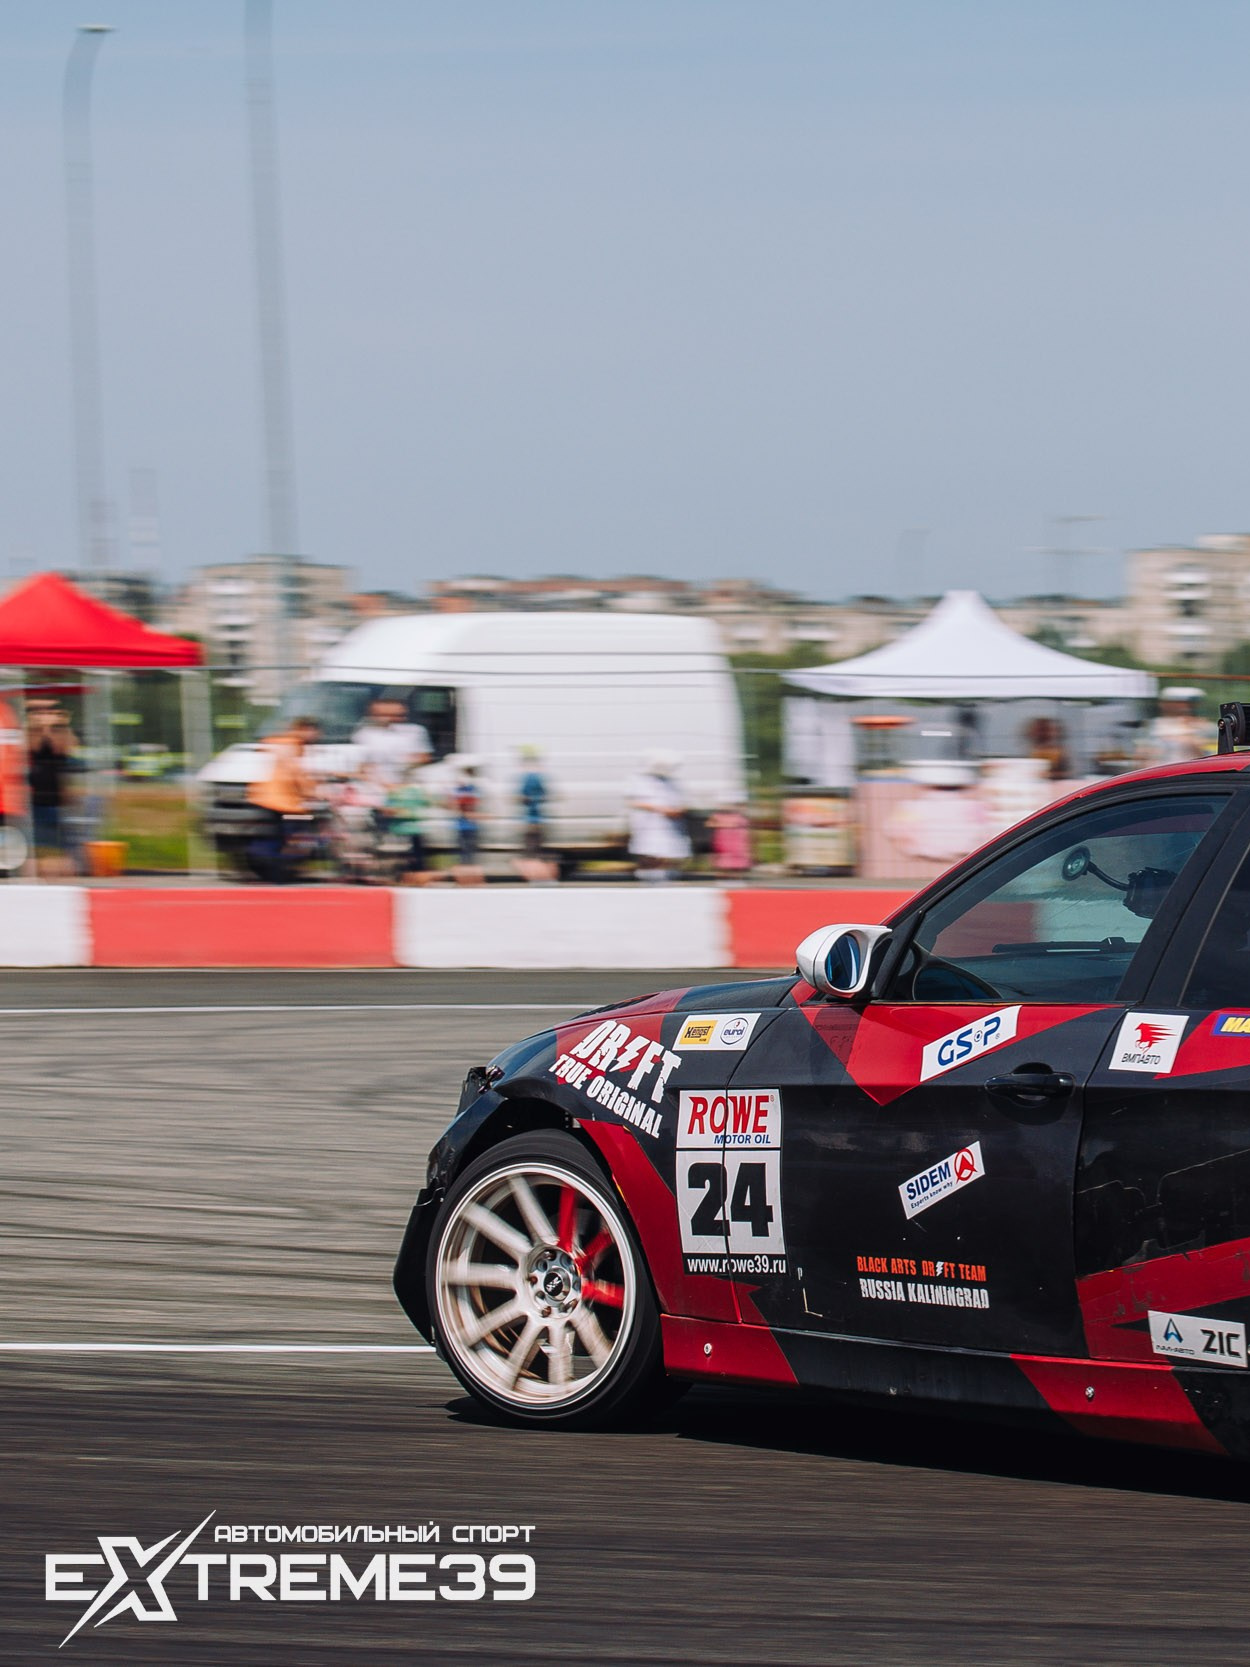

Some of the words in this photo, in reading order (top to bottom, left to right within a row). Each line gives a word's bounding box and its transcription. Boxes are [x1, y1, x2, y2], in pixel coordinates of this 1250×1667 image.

[938, 1016, 1000, 1066] GSP
[1121, 1053, 1161, 1065] ВМПАВТО
[548, 1054, 592, 1090] TRUE
[586, 1075, 663, 1139] ORIGINAL
[687, 1094, 769, 1134] ROWE
[714, 1134, 751, 1144] MOTOR
[755, 1134, 771, 1144] OIL
[906, 1161, 951, 1200] SIDEM
[910, 1195, 929, 1209] Experts
[929, 1187, 942, 1197] know
[943, 1181, 953, 1190] why
[688, 1162, 774, 1237] 24
[688, 1255, 786, 1274] www.rowe39.ru
[857, 1256, 888, 1273] BLACK
[891, 1258, 917, 1276] ARTS
[959, 1263, 987, 1282] TEAM
[859, 1278, 906, 1301] RUSSIA
[907, 1283, 990, 1309] KALININGRAD
[1200, 1329, 1242, 1358] ZIC
